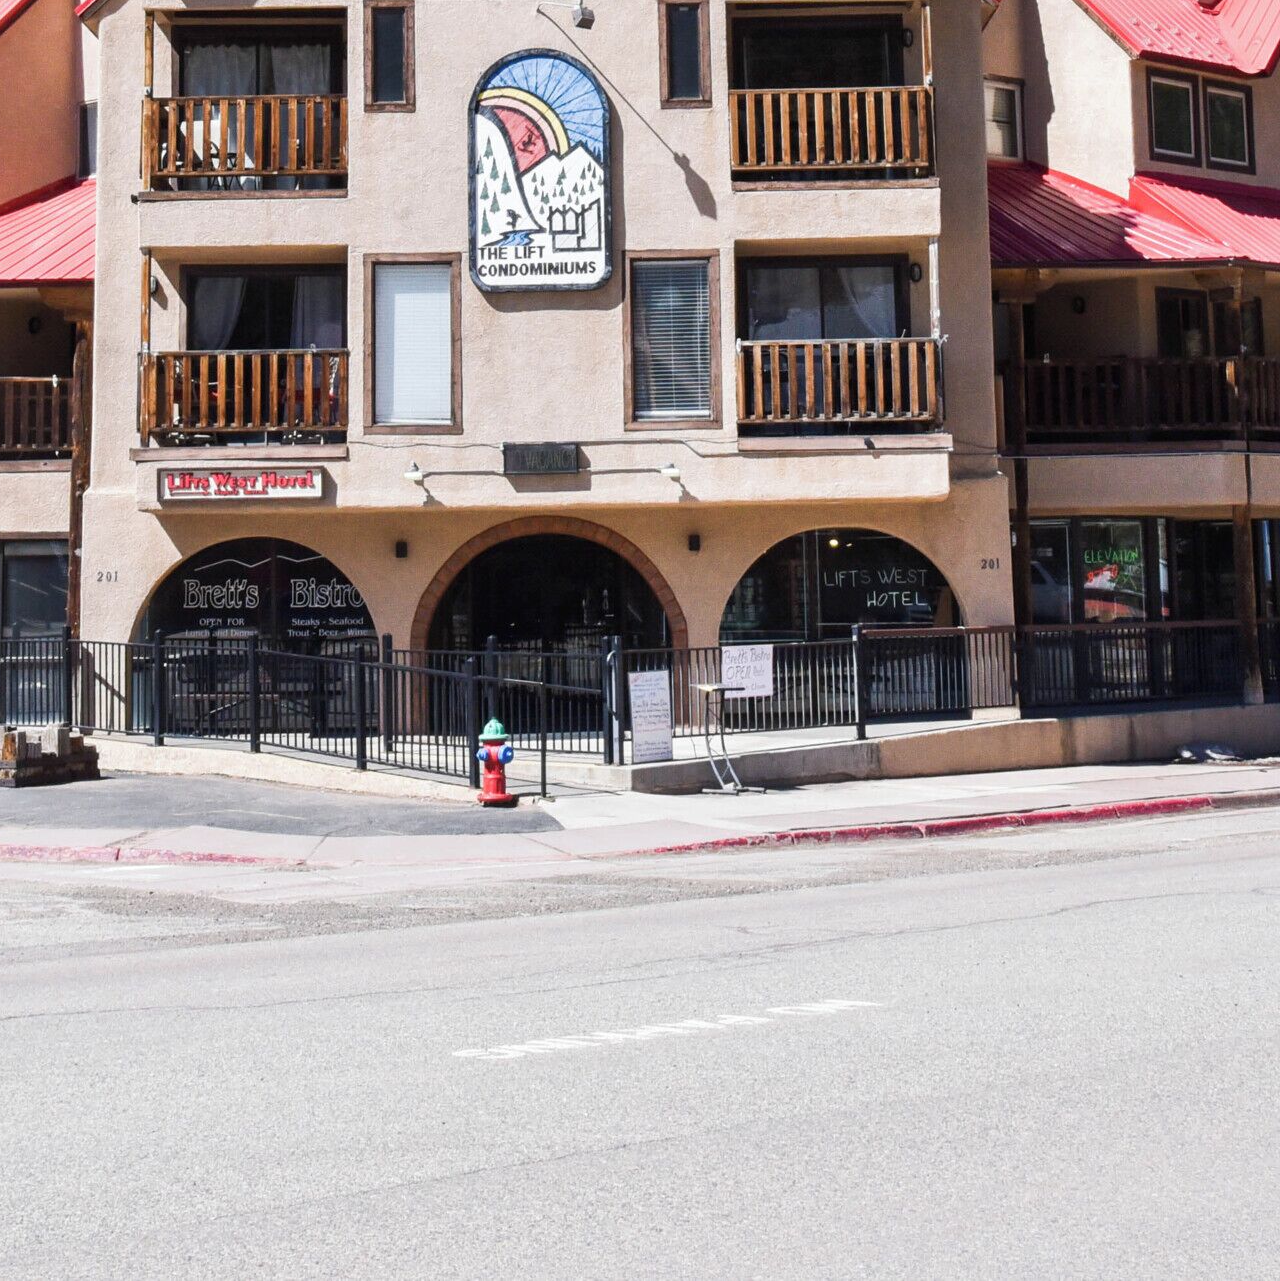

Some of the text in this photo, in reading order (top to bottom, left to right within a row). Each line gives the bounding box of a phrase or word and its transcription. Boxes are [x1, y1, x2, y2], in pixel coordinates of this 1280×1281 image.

[478, 245, 545, 259] THE LIFT
[478, 261, 596, 277] CONDOMINIUMS
[1084, 547, 1138, 564] ELEVATION
[981, 557, 1000, 570] 201
[97, 571, 118, 582] 201
[823, 567, 928, 587] LIFTS WEST
[183, 577, 365, 609] Brett's Bistro
[866, 591, 928, 607] HOTEL
[228, 618, 245, 626] FOR
[291, 617, 364, 626] Steaks Seafood
[288, 629, 310, 637] Trout
